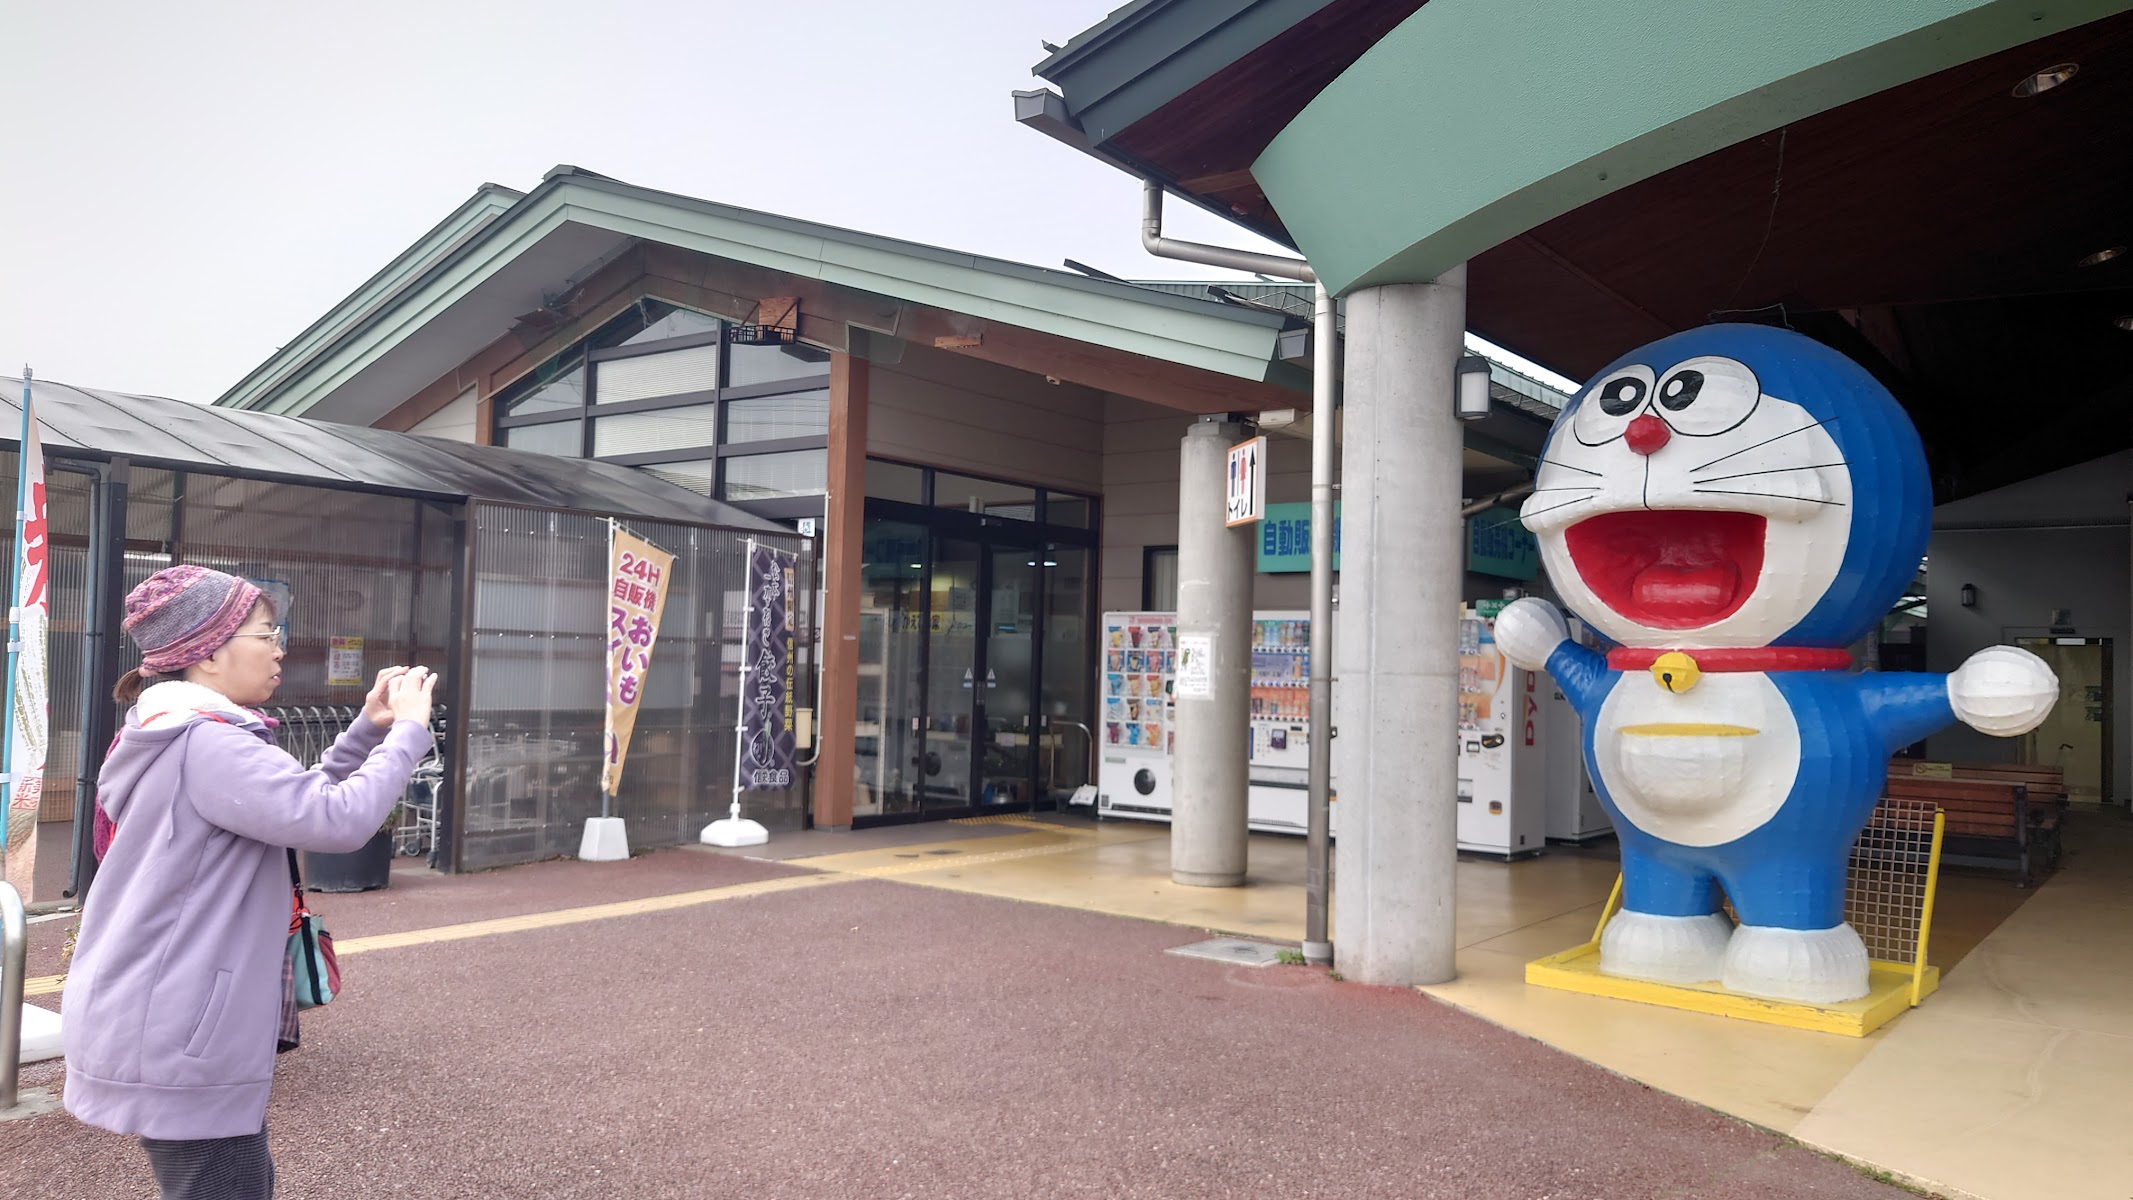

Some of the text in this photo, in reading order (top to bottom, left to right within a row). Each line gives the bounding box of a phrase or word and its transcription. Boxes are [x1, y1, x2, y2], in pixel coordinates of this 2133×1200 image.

[1227, 498, 1248, 521] トイレ
[618, 551, 661, 588] 24H
[613, 577, 657, 614] 自販機
[619, 615, 654, 705] おいも
